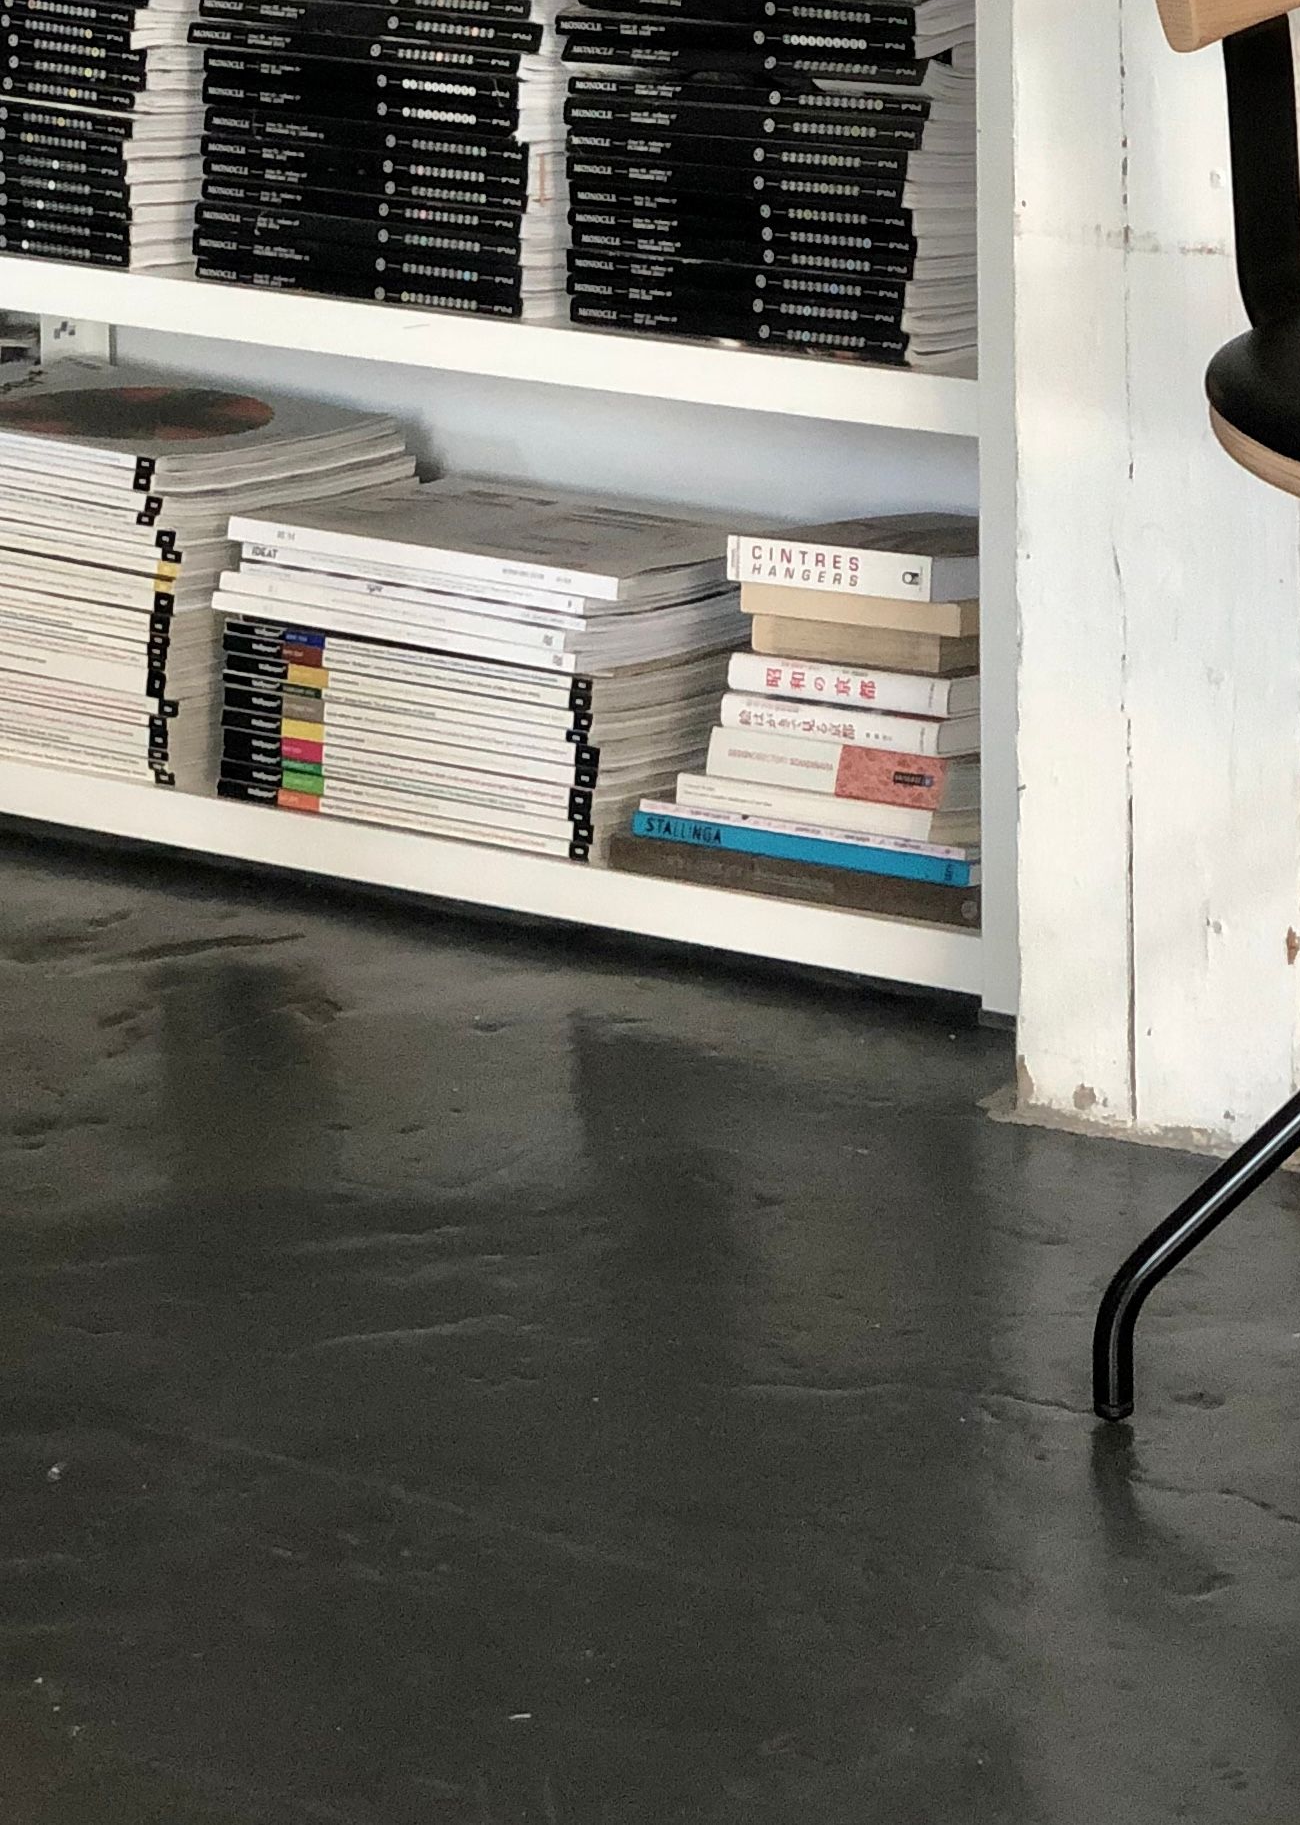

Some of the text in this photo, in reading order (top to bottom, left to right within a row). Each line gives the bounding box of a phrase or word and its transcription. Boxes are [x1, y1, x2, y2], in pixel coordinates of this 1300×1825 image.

[203, 0, 244, 10] MONOCLE
[560, 20, 602, 31] MONOCLE
[192, 29, 232, 40] MONOCLE
[572, 45, 615, 56] MONOCLE
[208, 58, 245, 70] MONOCLE
[575, 80, 618, 91] MONOCLE
[208, 86, 245, 98] MONOCLE
[571, 108, 613, 119] MONOCLE
[212, 117, 250, 129] MONOCLE
[569, 135, 611, 147] MONOCLE
[208, 143, 246, 155] MONOCLE
[211, 163, 249, 175] MONOCLE
[573, 164, 612, 175] MONOCLE
[207, 185, 245, 197] MONOCLE
[577, 191, 617, 202] MONOCLE
[202, 210, 241, 222] MONOCLE
[575, 213, 616, 224] MONOCLE
[199, 238, 238, 250] MONOCLE
[581, 234, 621, 246] MONOCLE
[575, 258, 614, 270] MONOCLE
[199, 267, 237, 279] MONOCLE
[574, 283, 614, 295] MONOCLE
[578, 307, 617, 319] MONOCLE
[251, 546, 278, 559] IDEAT
[752, 544, 859, 572] CINTRES
[752, 563, 859, 587] HANGERS
[765, 667, 877, 700] 昭和の京都
[645, 817, 722, 845] STALLINGA
